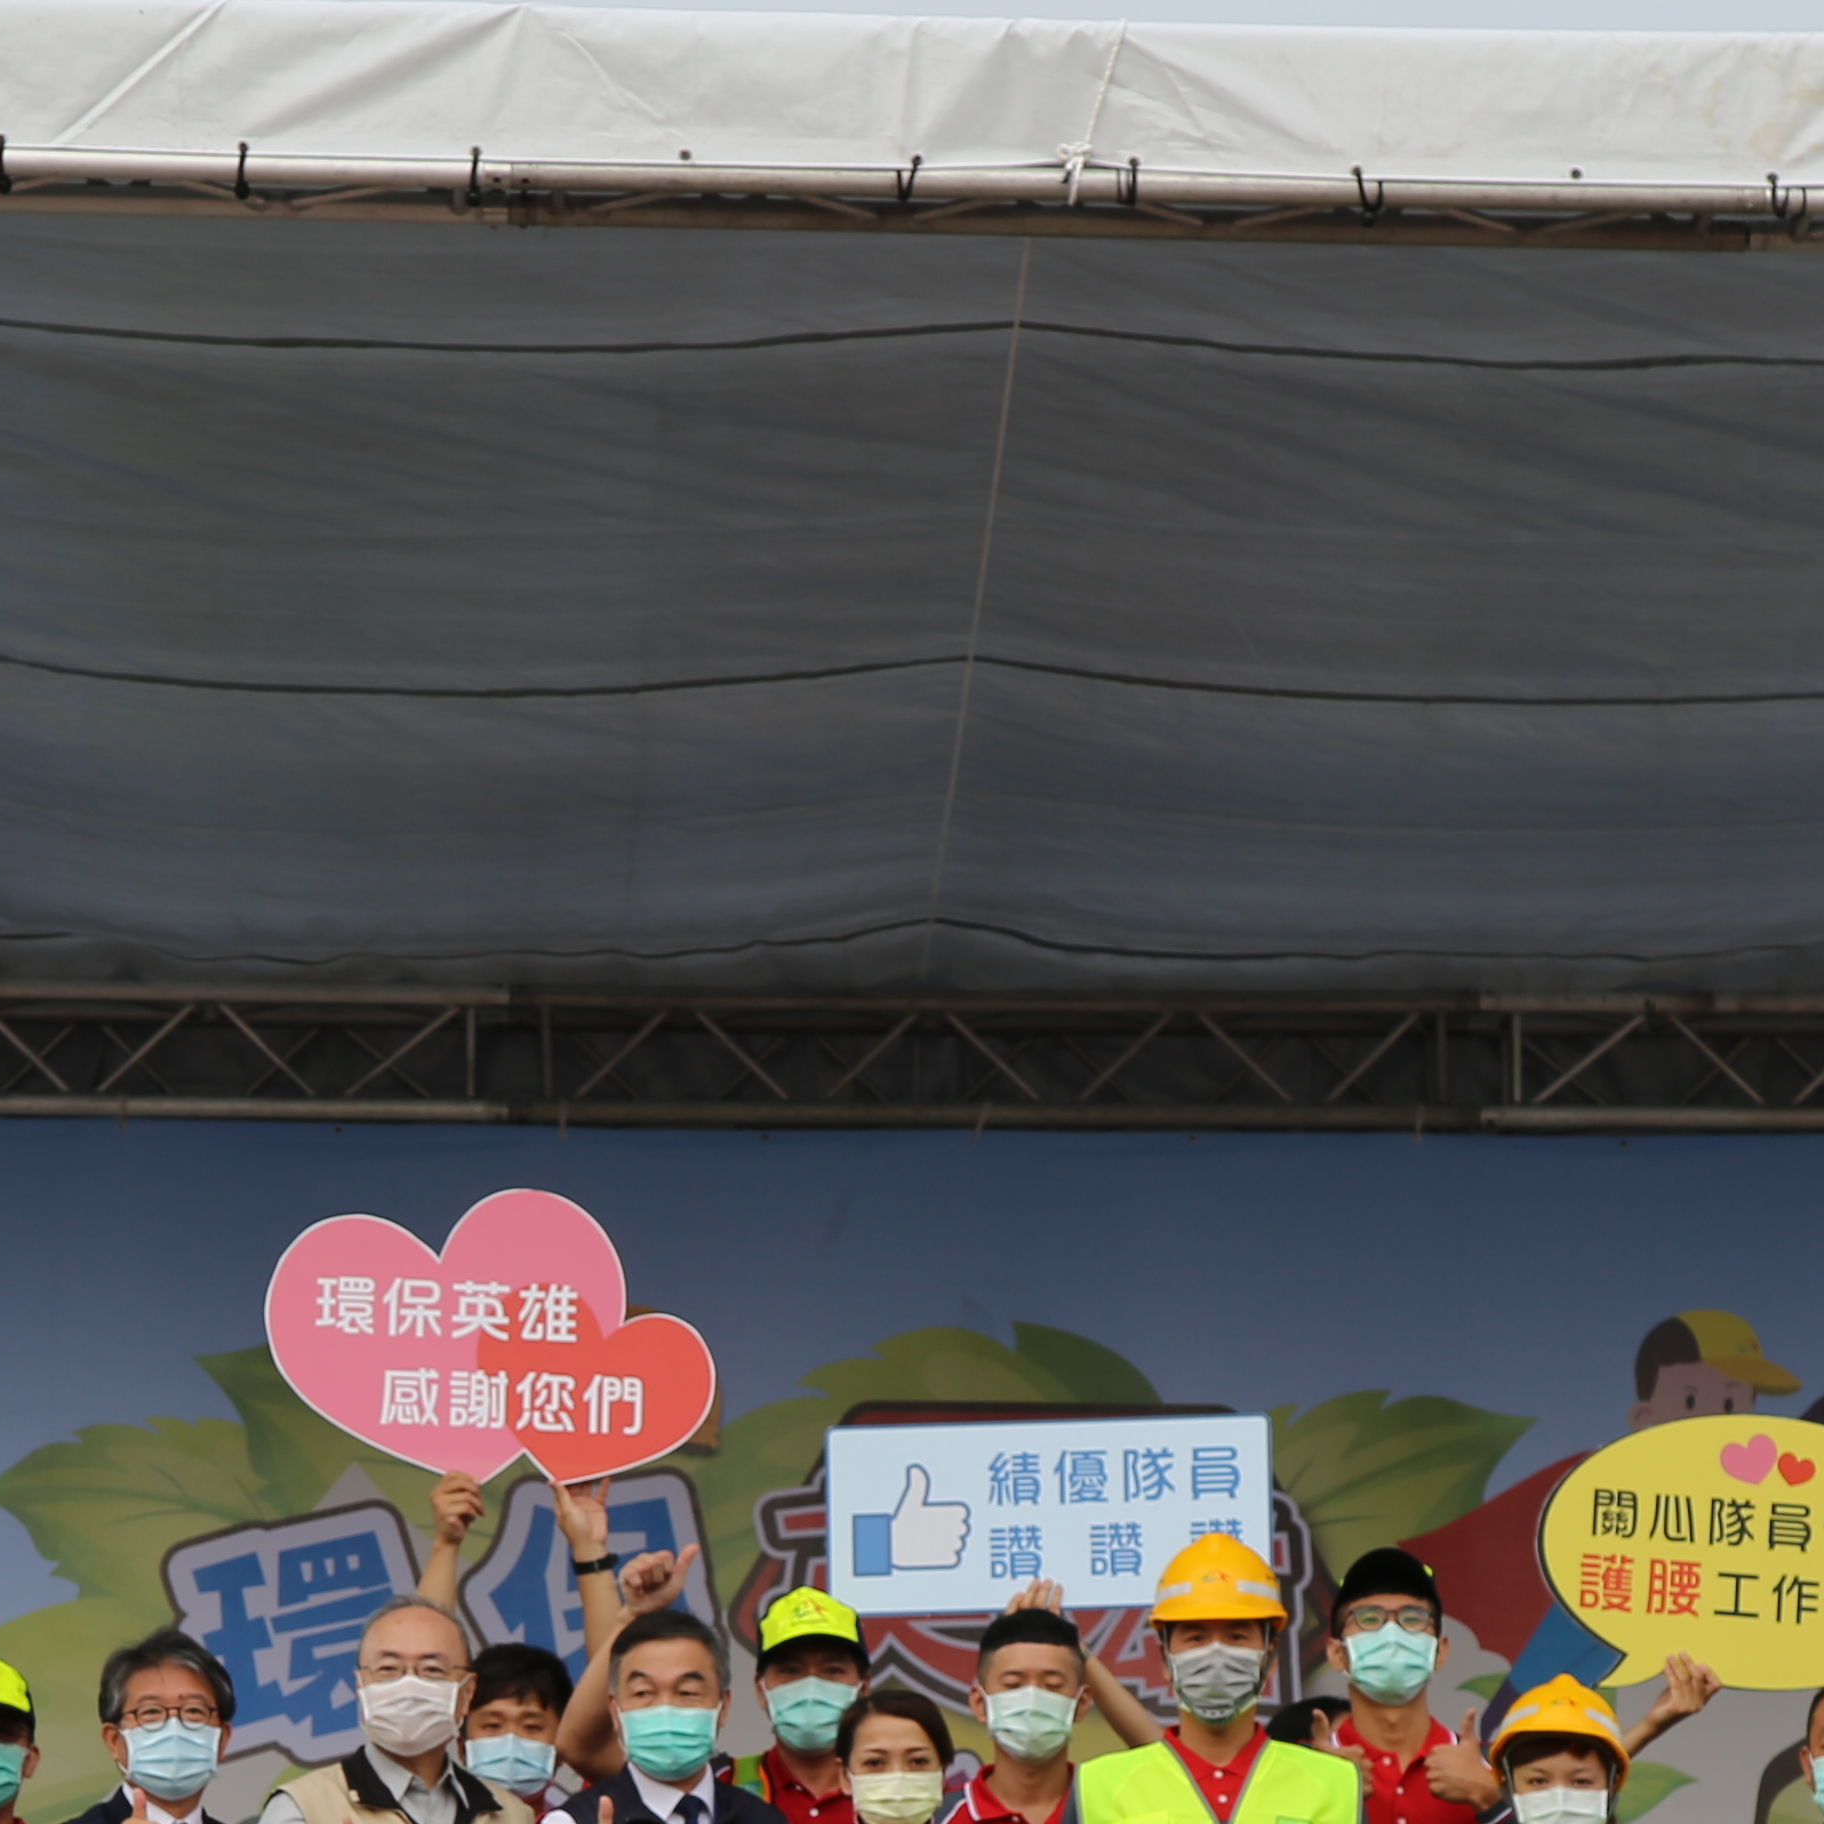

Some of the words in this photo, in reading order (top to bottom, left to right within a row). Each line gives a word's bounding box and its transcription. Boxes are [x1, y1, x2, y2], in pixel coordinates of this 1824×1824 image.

[315, 1276, 579, 1343] 環保英雄
[380, 1368, 644, 1437] 感謝您們
[988, 1446, 1242, 1506] 績優隊員
